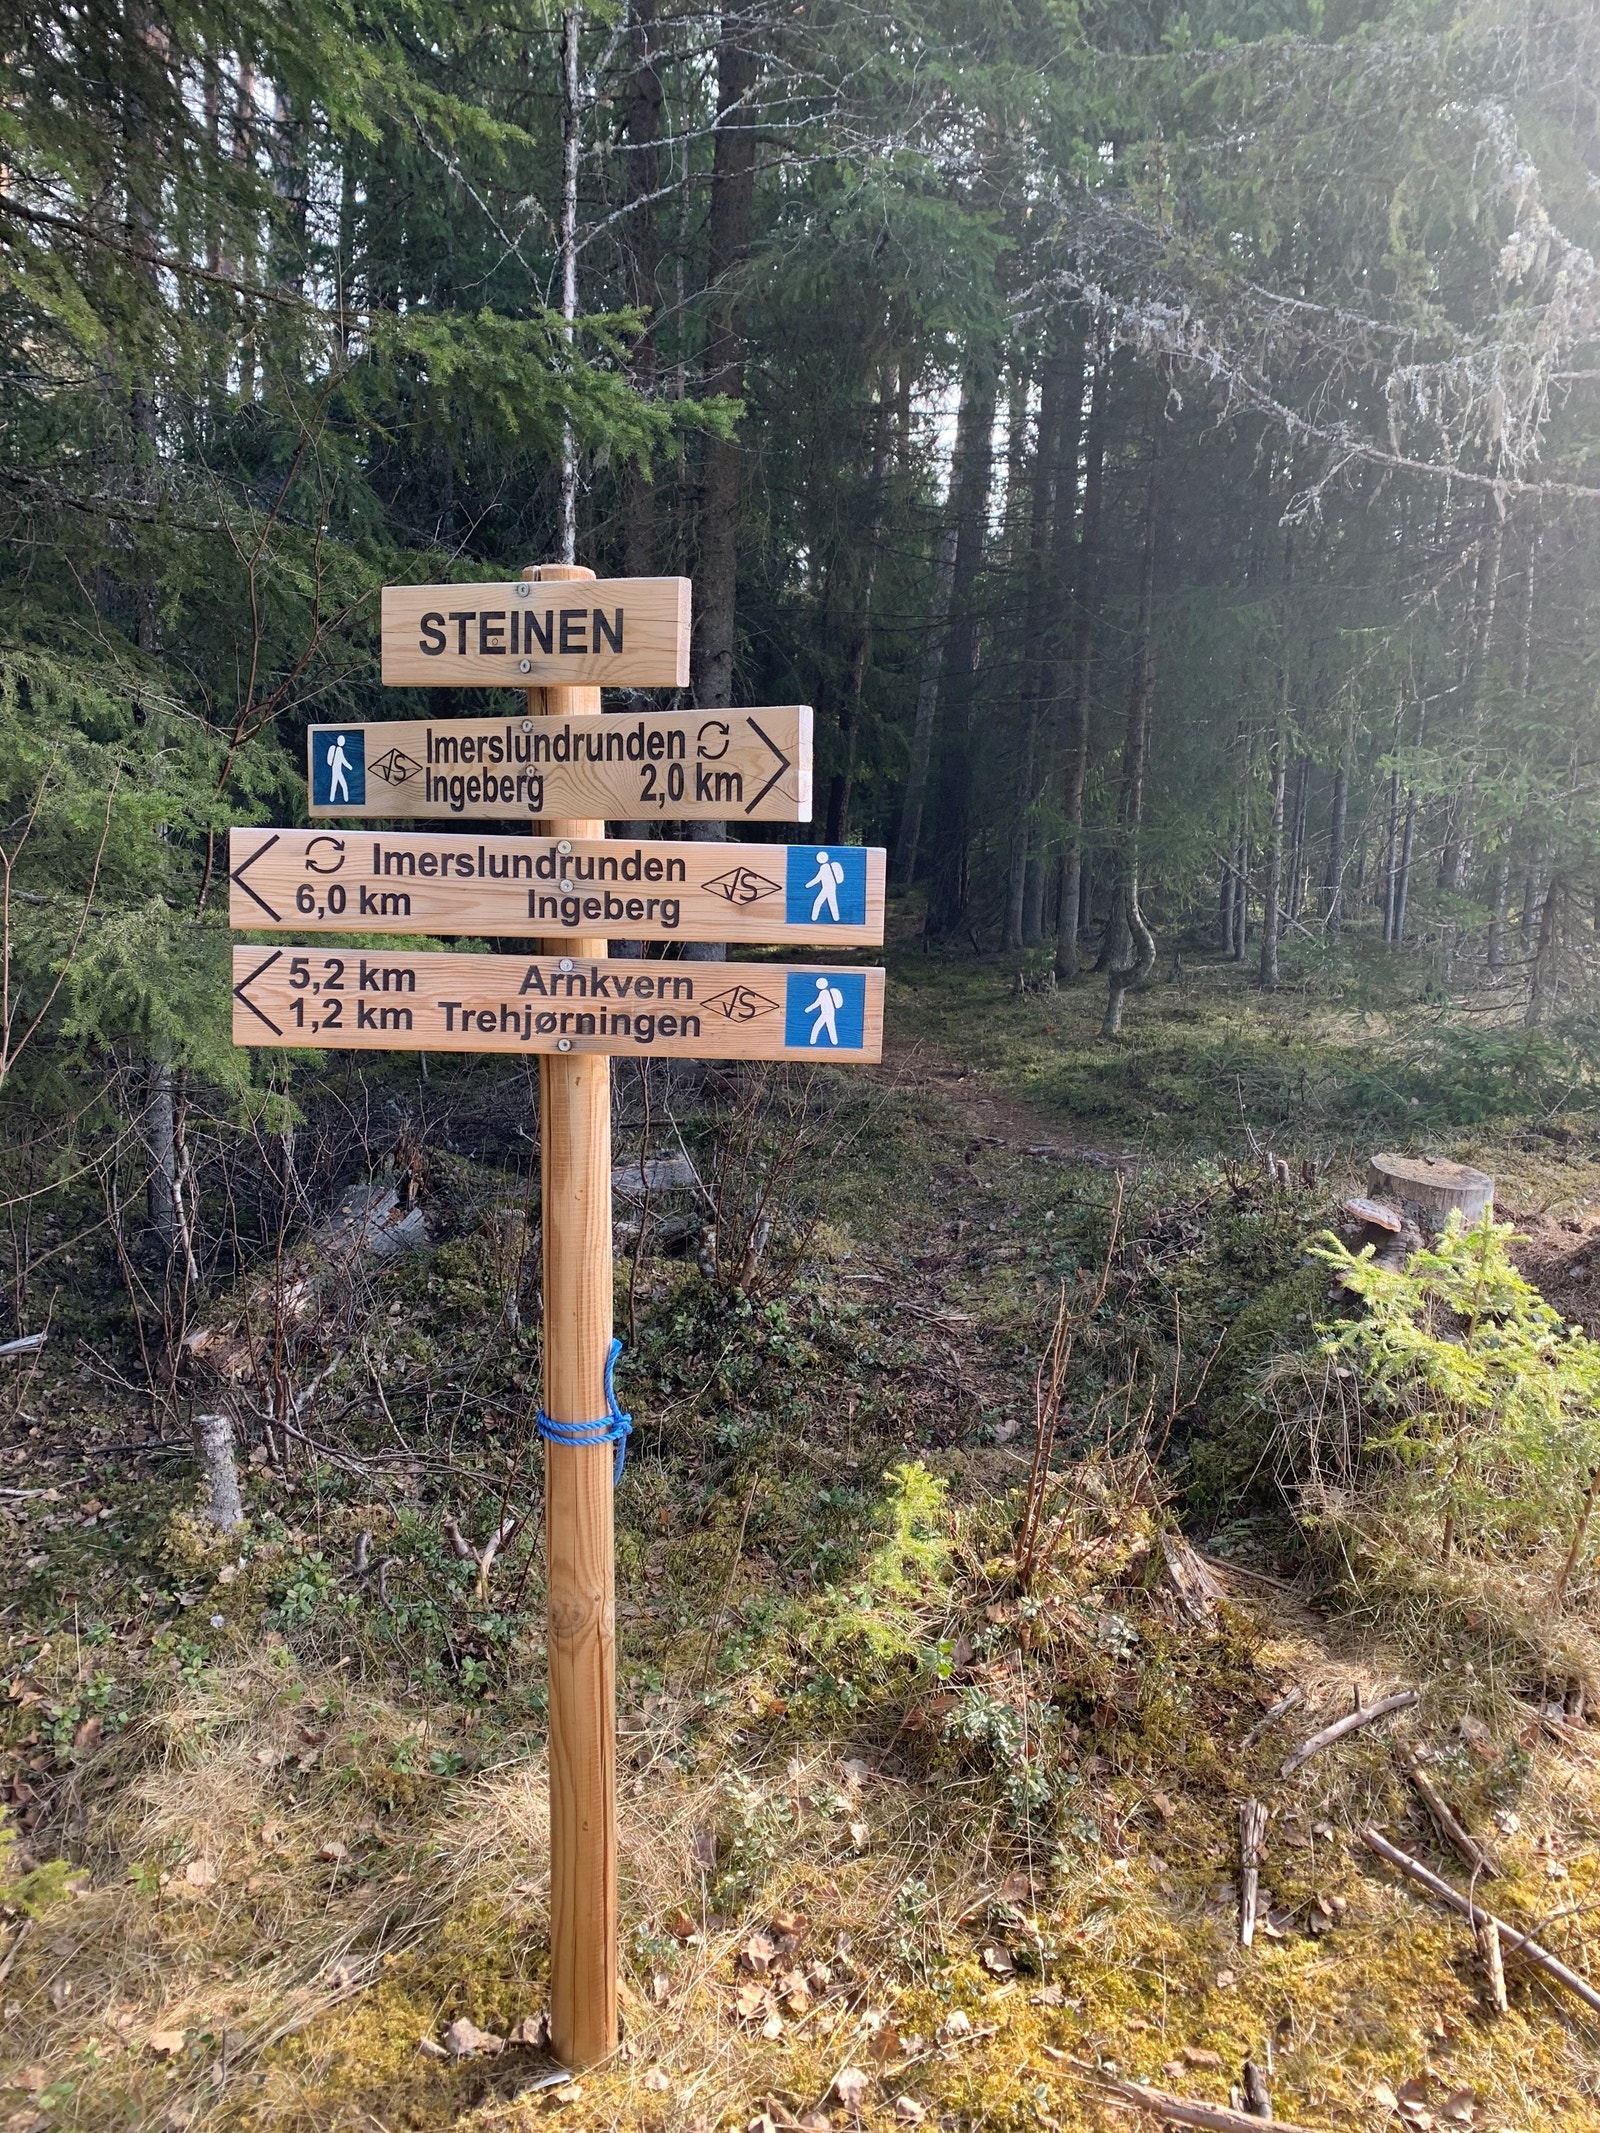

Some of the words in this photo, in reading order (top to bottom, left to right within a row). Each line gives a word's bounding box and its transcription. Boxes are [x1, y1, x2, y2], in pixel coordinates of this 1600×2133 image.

[419, 608, 624, 656] STEINEN
[426, 722, 685, 765] Imerslundrunden
[425, 766, 544, 812] Ingeberg
[640, 763, 685, 809] 2,0
[696, 766, 743, 802] km
[373, 842, 686, 882] Imerslundrunden
[296, 884, 346, 920] 6,0
[360, 884, 412, 915] km
[528, 888, 680, 928] Ingeberg
[289, 958, 345, 995] 5,2
[359, 960, 416, 992] km
[519, 965, 694, 1000] Arnkvern
[290, 999, 344, 1034] 1,2
[357, 999, 413, 1030] km
[438, 1001, 701, 1043] Trehjørningen
